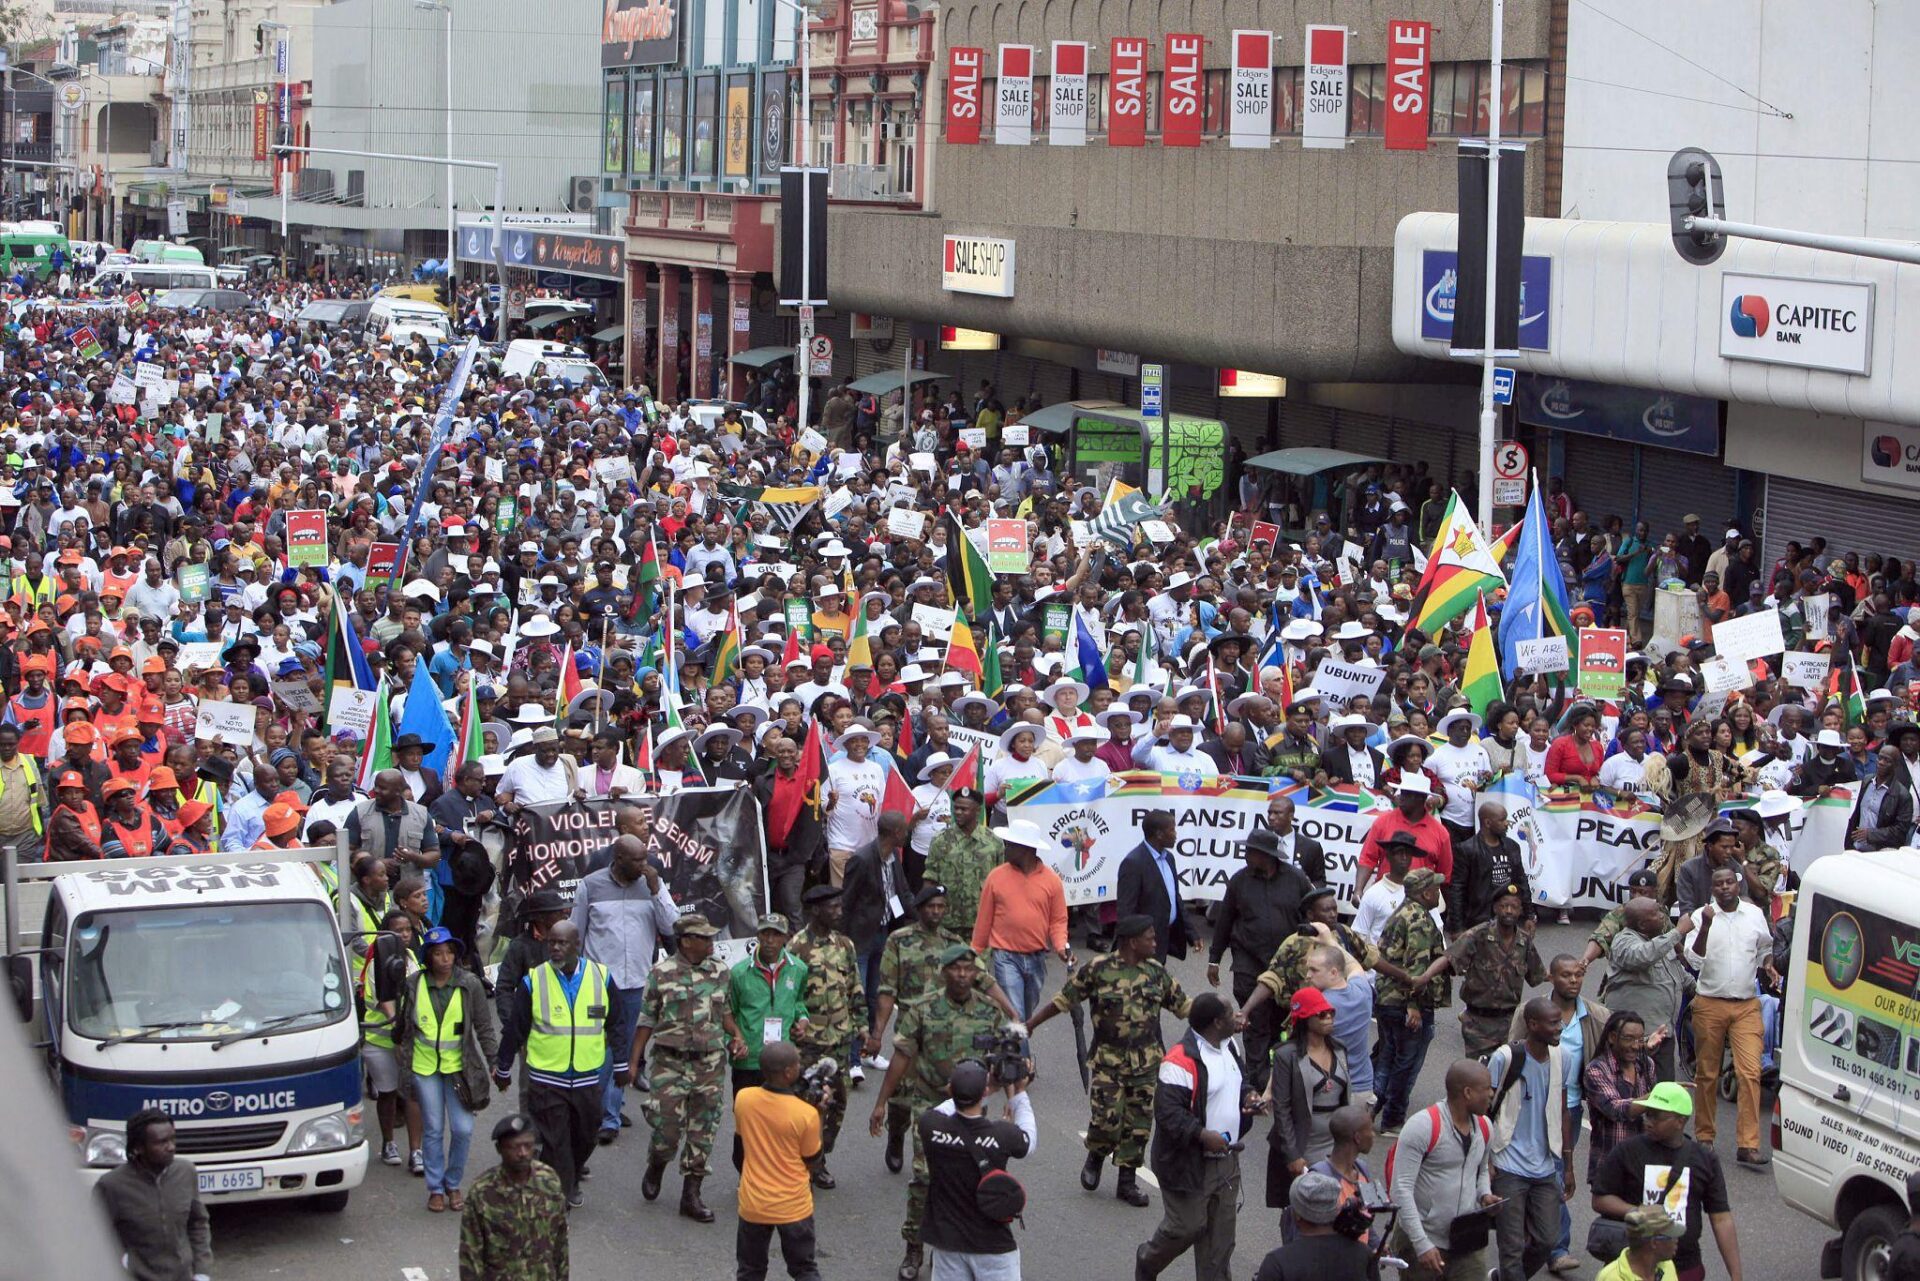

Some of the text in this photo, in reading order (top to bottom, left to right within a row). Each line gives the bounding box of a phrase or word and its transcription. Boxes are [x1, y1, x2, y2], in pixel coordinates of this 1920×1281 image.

[1114, 42, 1143, 115] SALE
[1169, 38, 1199, 116] SALE
[1392, 26, 1425, 114] SALE
[952, 52, 978, 118] SALE
[1055, 87, 1084, 102] SALE
[1237, 83, 1268, 98] SALE
[1310, 80, 1343, 97] SALE
[1002, 89, 1029, 103] SALE
[1001, 104, 1029, 117] SHOP
[1055, 103, 1084, 116] SHOP
[1236, 100, 1268, 115] SHOP
[1309, 98, 1343, 114] SHOP
[955, 240, 1005, 276] SALE SHOP
[1776, 303, 1857, 333] CAPITEC
[1776, 331, 1802, 344] BANK
[1389, 539, 1406, 547] POLICE
[757, 565, 782, 574] GIVE
[182, 575, 206, 588] STOP
[1046, 611, 1069, 620] PHANSI
[1046, 619, 1067, 628] NGE
[1520, 644, 1562, 656] WE ARE
[1324, 665, 1377, 684] UBUNTU
[215, 725, 251, 733] XENOPHOBIA
[852, 784, 871, 799] AFRICA
[1049, 808, 1110, 842] AFRICA UNITE
[1131, 808, 1246, 830] PANSI
[1507, 806, 1531, 831] AFRIC
[655, 817, 714, 865] SEXISM
[1576, 818, 1660, 852] PEAC
[519, 861, 562, 897] HATE
[1073, 856, 1107, 884] XENOPHOBIA
[1178, 867, 1230, 887] KWA
[1874, 995, 1896, 1014] OUR
[1832, 1055, 1850, 1072] TEL:
[1851, 1063, 1867, 1079] 031
[1886, 1078, 1908, 1096] 2917
[142, 1090, 296, 1116] METRO POLICE
[1820, 1115, 1844, 1134] SALES,
[1845, 1127, 1863, 1141] HIRE
[1863, 1134, 1880, 1148] AND
[1783, 1118, 1911, 1182] SOUND VIDEO BIG SCREEN
[200, 1172, 254, 1189] DM 6695
